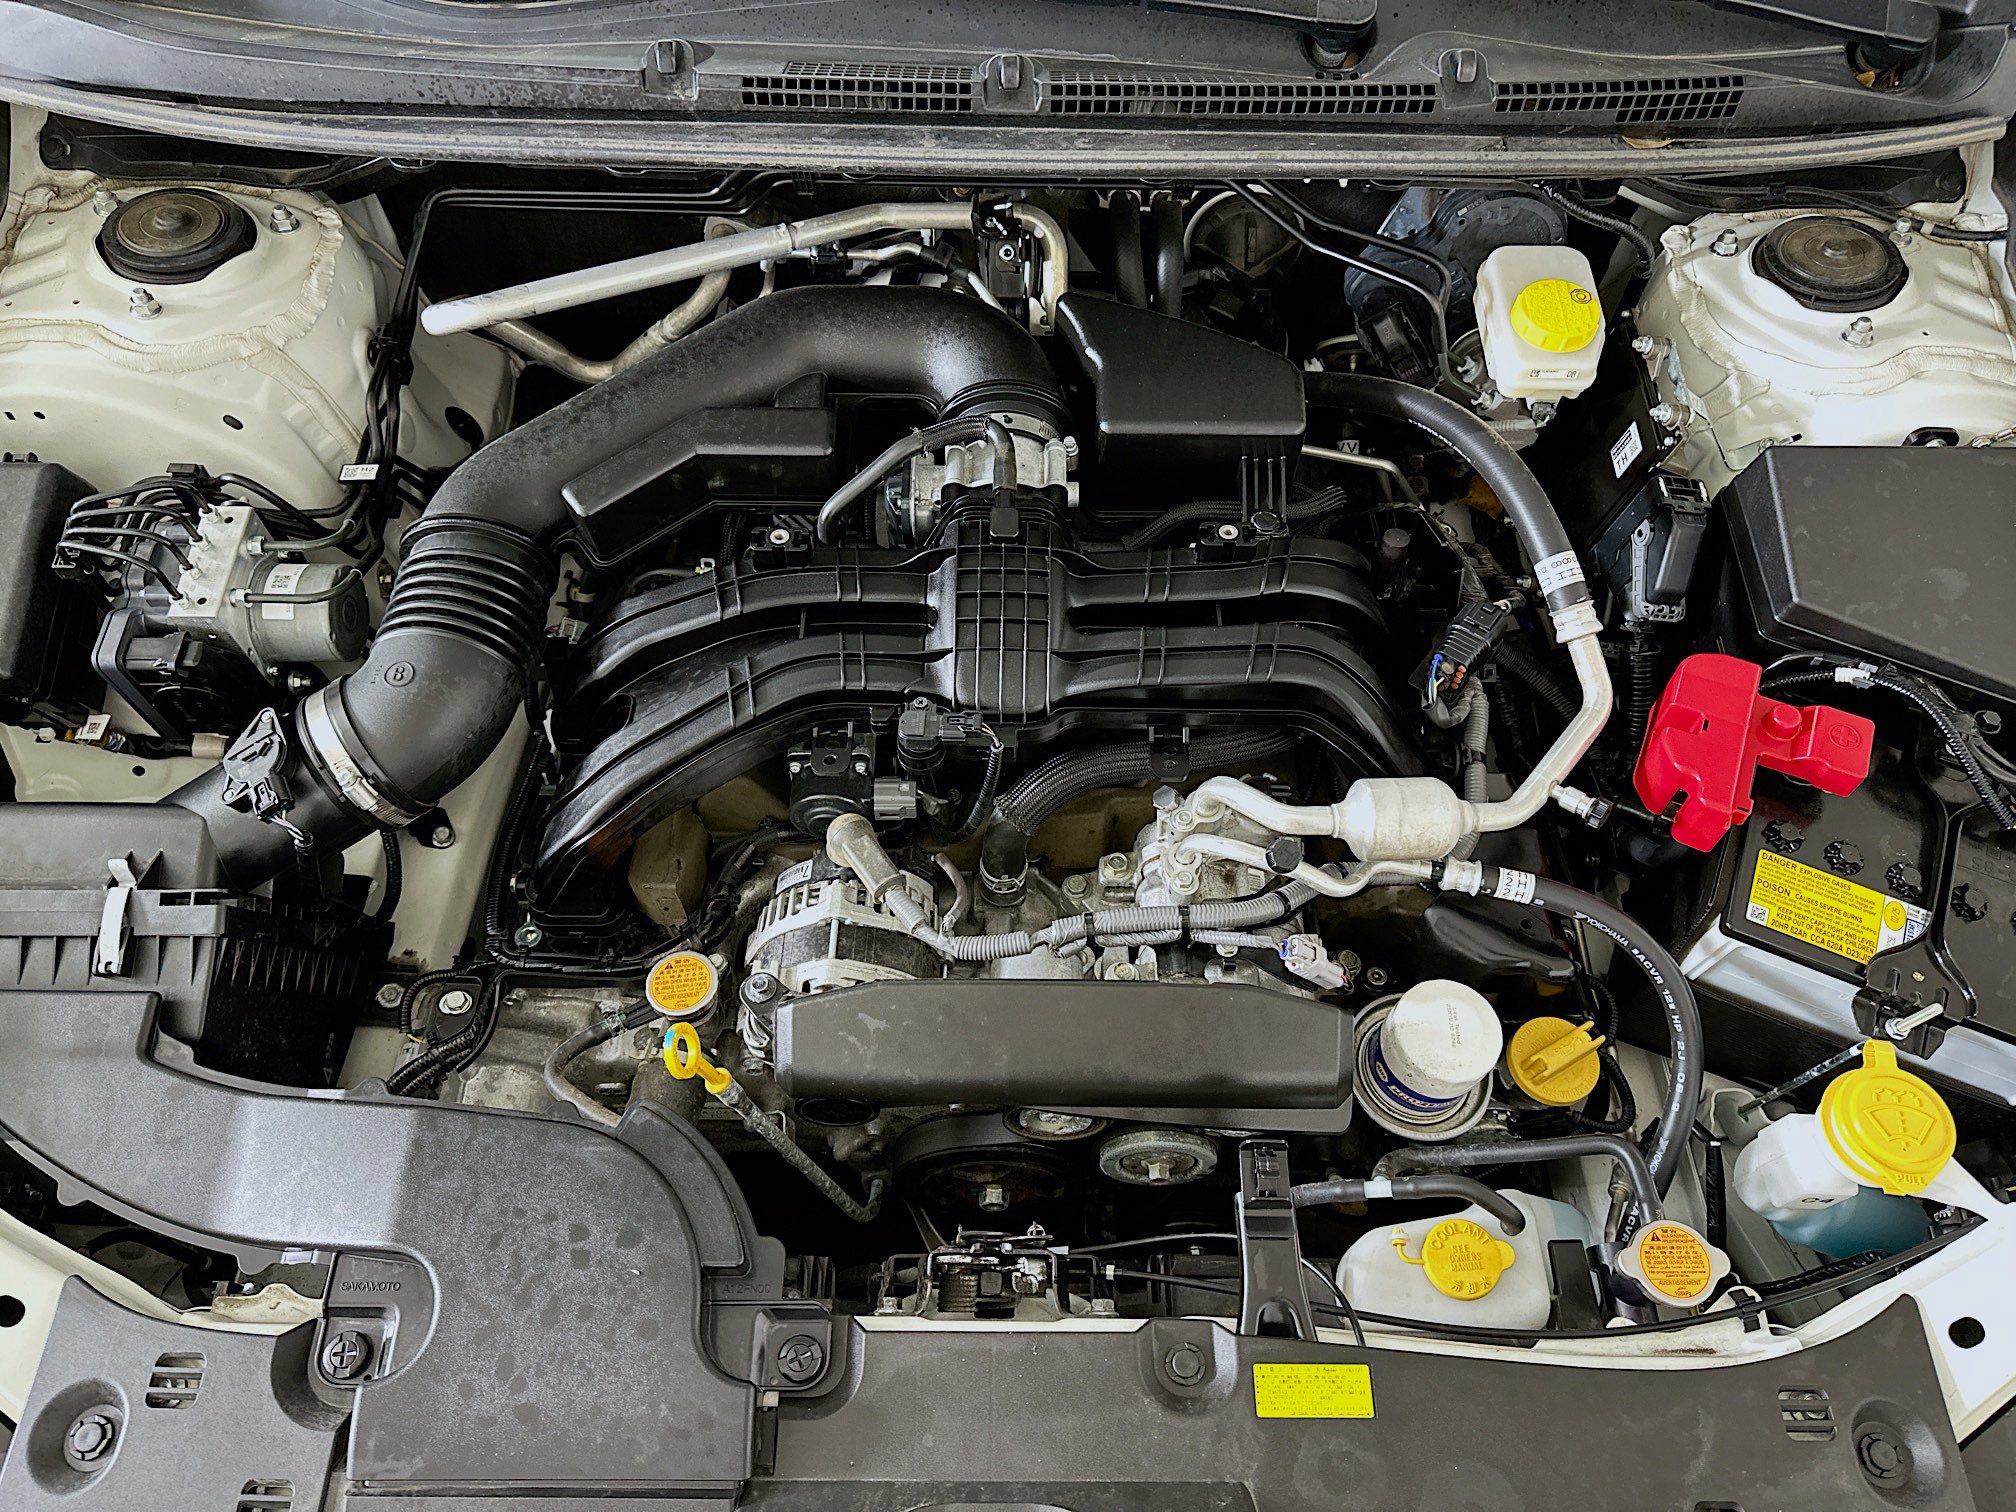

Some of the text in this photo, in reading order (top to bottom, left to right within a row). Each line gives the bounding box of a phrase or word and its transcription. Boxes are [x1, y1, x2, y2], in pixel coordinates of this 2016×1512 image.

[1616, 452, 1629, 470] TH
[393, 666, 405, 682] B
[1761, 851, 1851, 891] DANGER EXPLOSIVE GASES
[1756, 877, 1863, 923] POISON CAUSES SEVERE BURNS
[1770, 917, 1789, 932] 20HR
[1789, 925, 1808, 938] 62Ah
[1810, 932, 1826, 945] CCA
[1825, 938, 1844, 952] 620A
[1775, 911, 1791, 922] KEEP
[1792, 917, 1805, 927] OUT
[1805, 923, 1813, 931] OF
[1814, 926, 1835, 939] REACH
[1835, 934, 1844, 942] OF
[1844, 937, 1874, 954] CHILDREN
[1777, 905, 1793, 916] KEEP
[1793, 911, 1809, 922] VENT
[1809, 917, 1826, 928] CAPS
[1826, 923, 1844, 935] TIGHT
[1844, 930, 1857, 940] AND
[1857, 935, 1876, 948] LEVEL
[1586, 917, 1629, 947] YOKOHAMA
[1671, 1015, 1683, 1033] HP
[1896, 1174, 1927, 1186] PULL
[1430, 1222, 1491, 1249] COOLANT
[1452, 1244, 1469, 1254] SEE
[1450, 1262, 1484, 1272] MANUAL
[341, 1281, 401, 1292] SAKAMOTO
